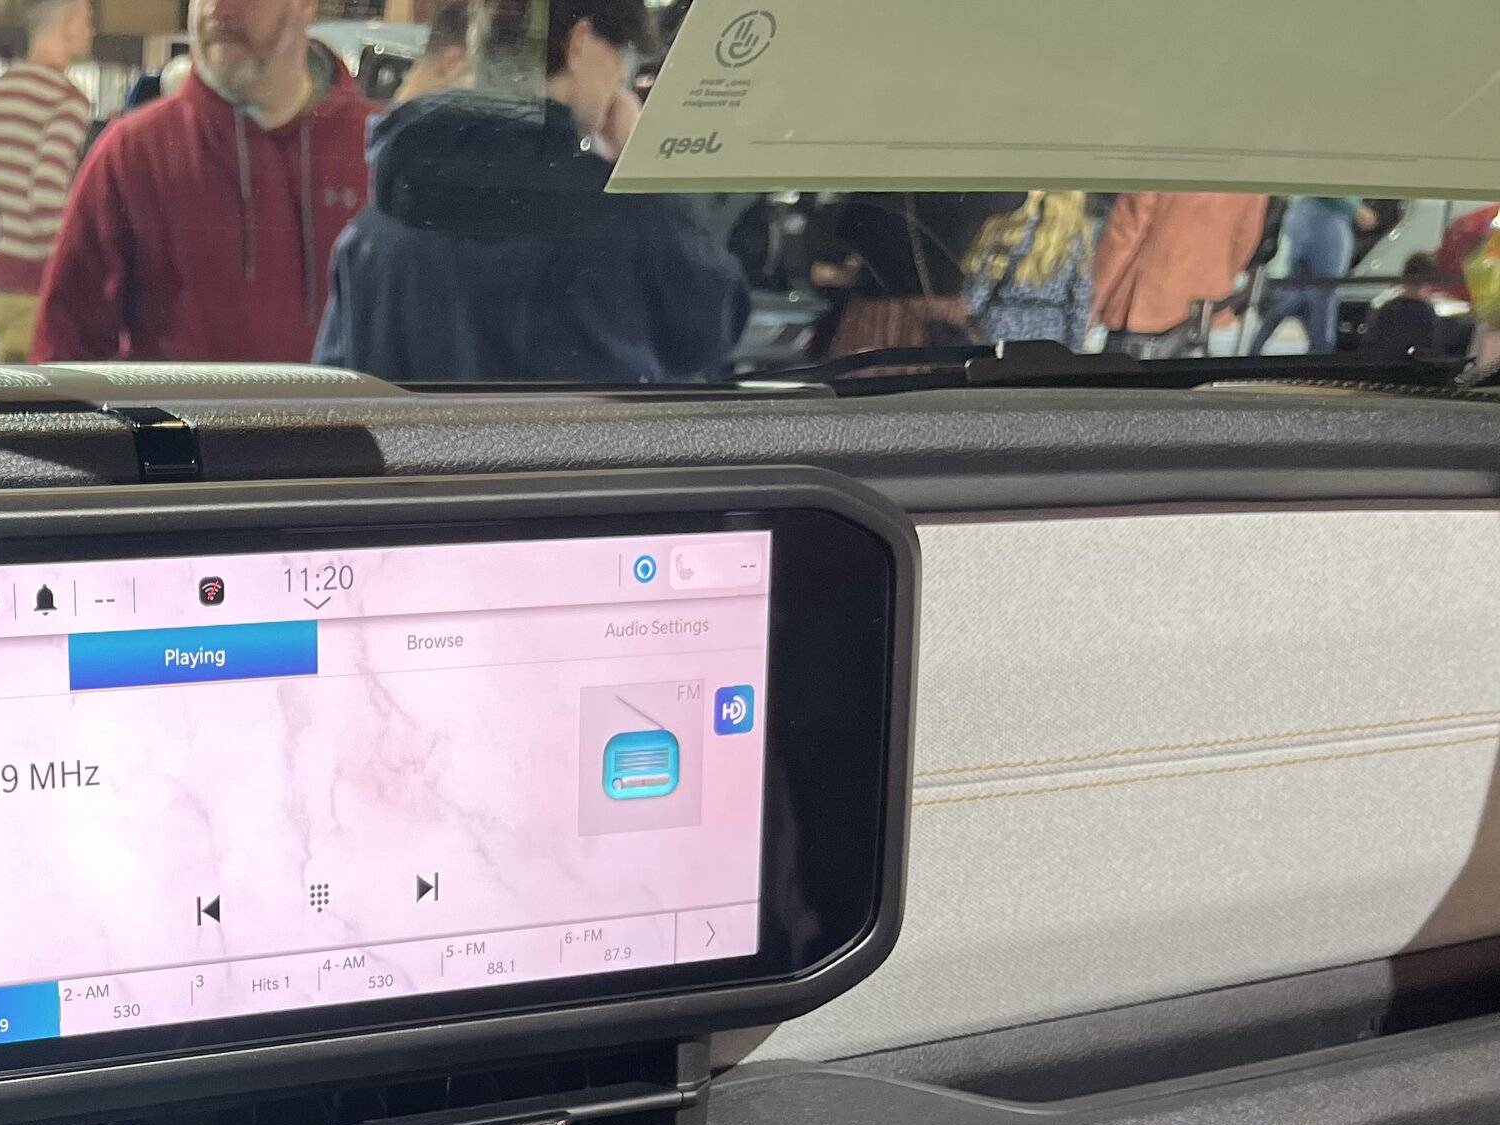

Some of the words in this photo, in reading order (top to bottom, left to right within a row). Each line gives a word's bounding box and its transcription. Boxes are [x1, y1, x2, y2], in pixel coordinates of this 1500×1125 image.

[283, 565, 354, 592] 11:20
[605, 620, 648, 639] Audio
[651, 617, 710, 638] Settings
[407, 633, 464, 651] Browse
[164, 647, 226, 669] Playing
[677, 684, 701, 701] FM
[29, 759, 101, 791] MHz
[565, 931, 573, 945] 6
[583, 928, 603, 942] FM
[446, 944, 454, 958] 5
[465, 941, 486, 956] FM
[604, 946, 632, 962] 87.9
[322, 959, 332, 972] 4
[343, 956, 366, 970] AM
[486, 960, 515, 976] 88.1
[196, 975, 205, 988] 3
[251, 976, 280, 993] Hits
[284, 975, 290, 990] 1
[368, 974, 394, 989] 530
[64, 988, 73, 1002] 2
[86, 984, 110, 999] AM
[113, 1003, 141, 1019] 530
